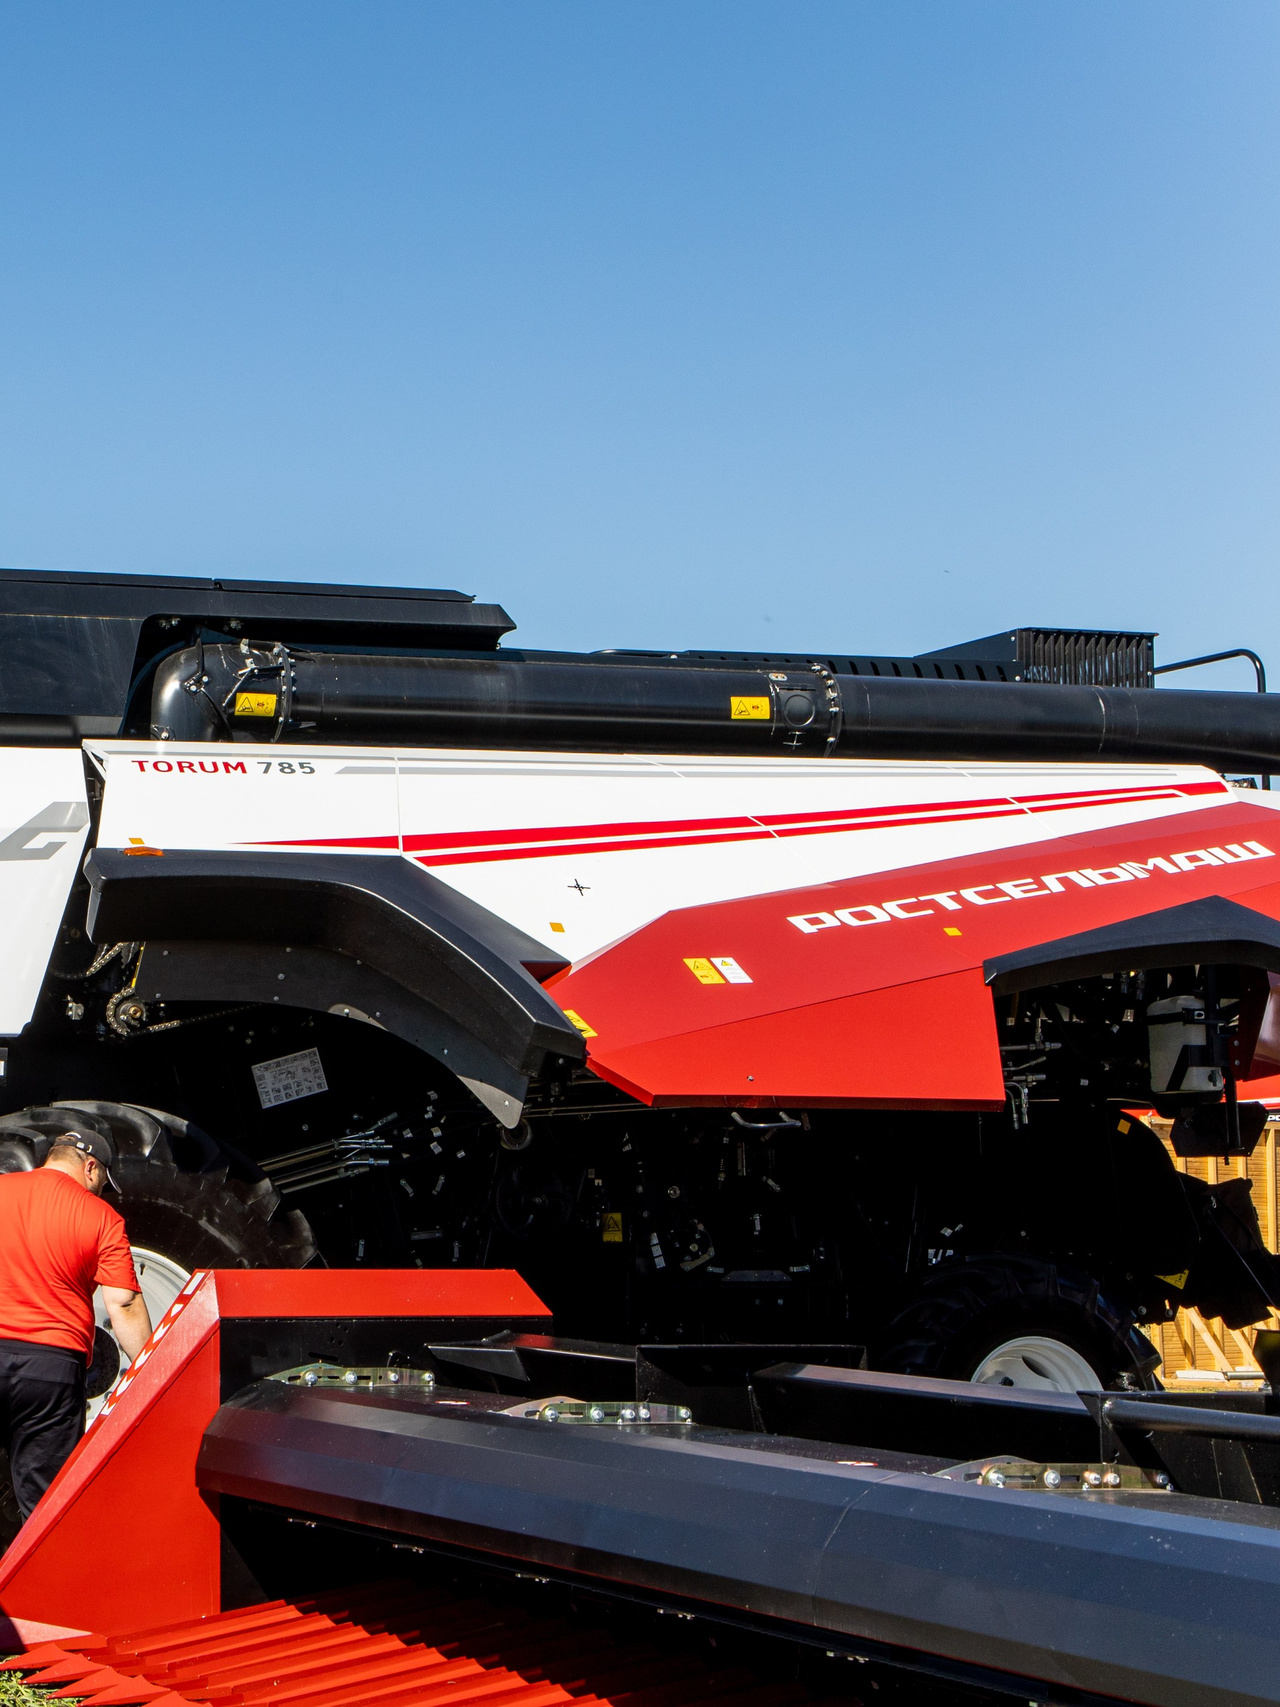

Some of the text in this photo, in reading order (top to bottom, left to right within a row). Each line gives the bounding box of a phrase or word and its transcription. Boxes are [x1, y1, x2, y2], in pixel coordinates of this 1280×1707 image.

[131, 760, 316, 775] TORUM 785
[786, 840, 1276, 934] РОСТСЕЛЬМАШ
